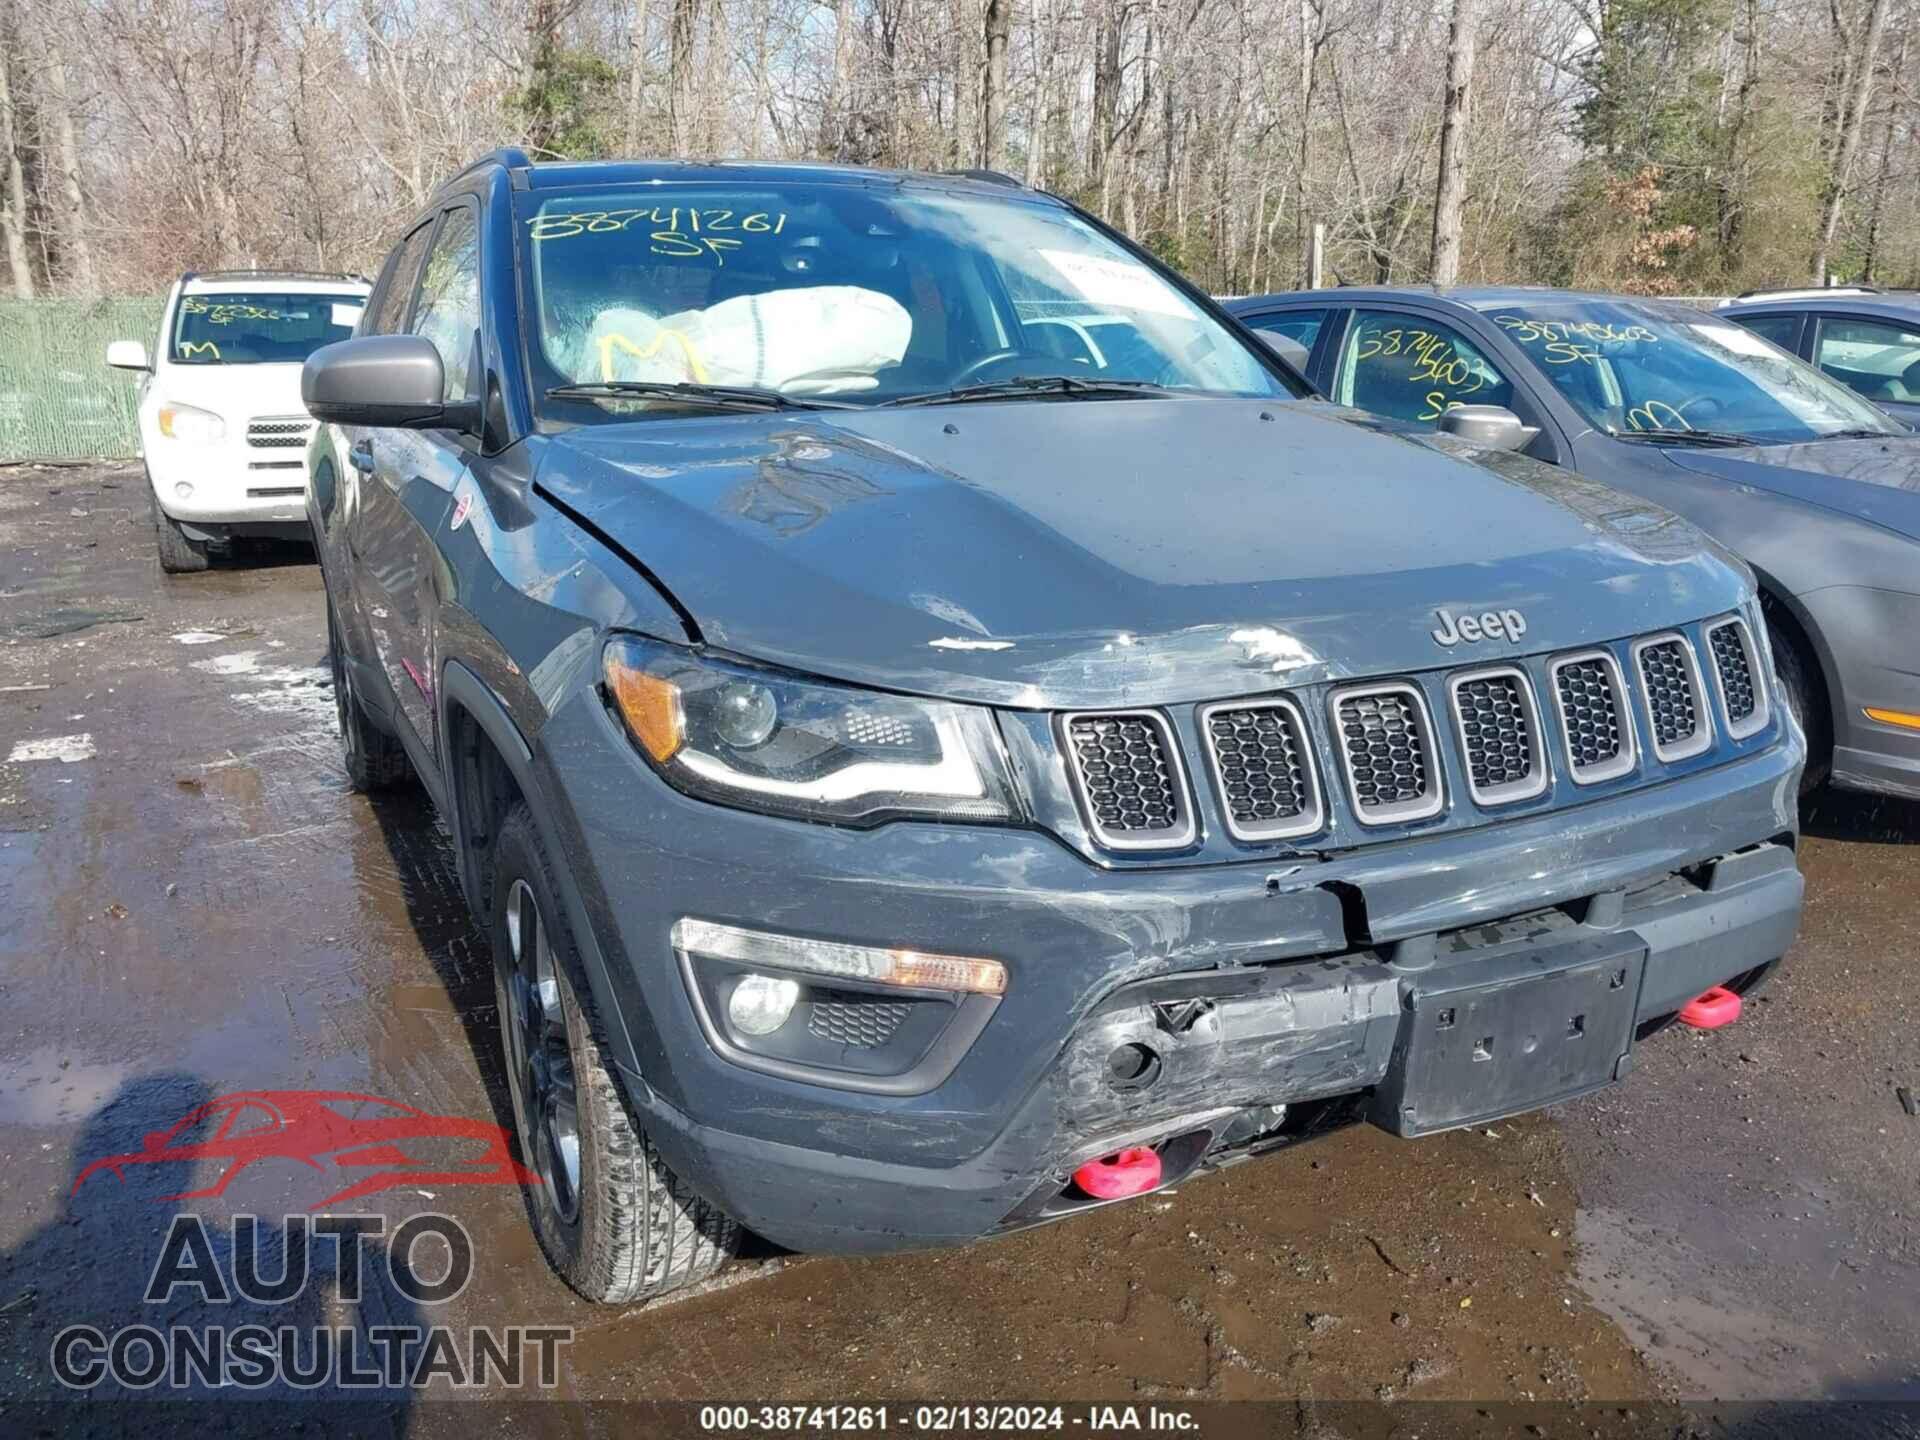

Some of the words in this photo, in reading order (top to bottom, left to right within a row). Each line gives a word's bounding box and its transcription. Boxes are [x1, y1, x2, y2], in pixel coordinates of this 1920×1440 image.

[525, 206, 786, 240] 38741261
[650, 231, 743, 267] SF
[1431, 608, 1527, 646] Jeep
